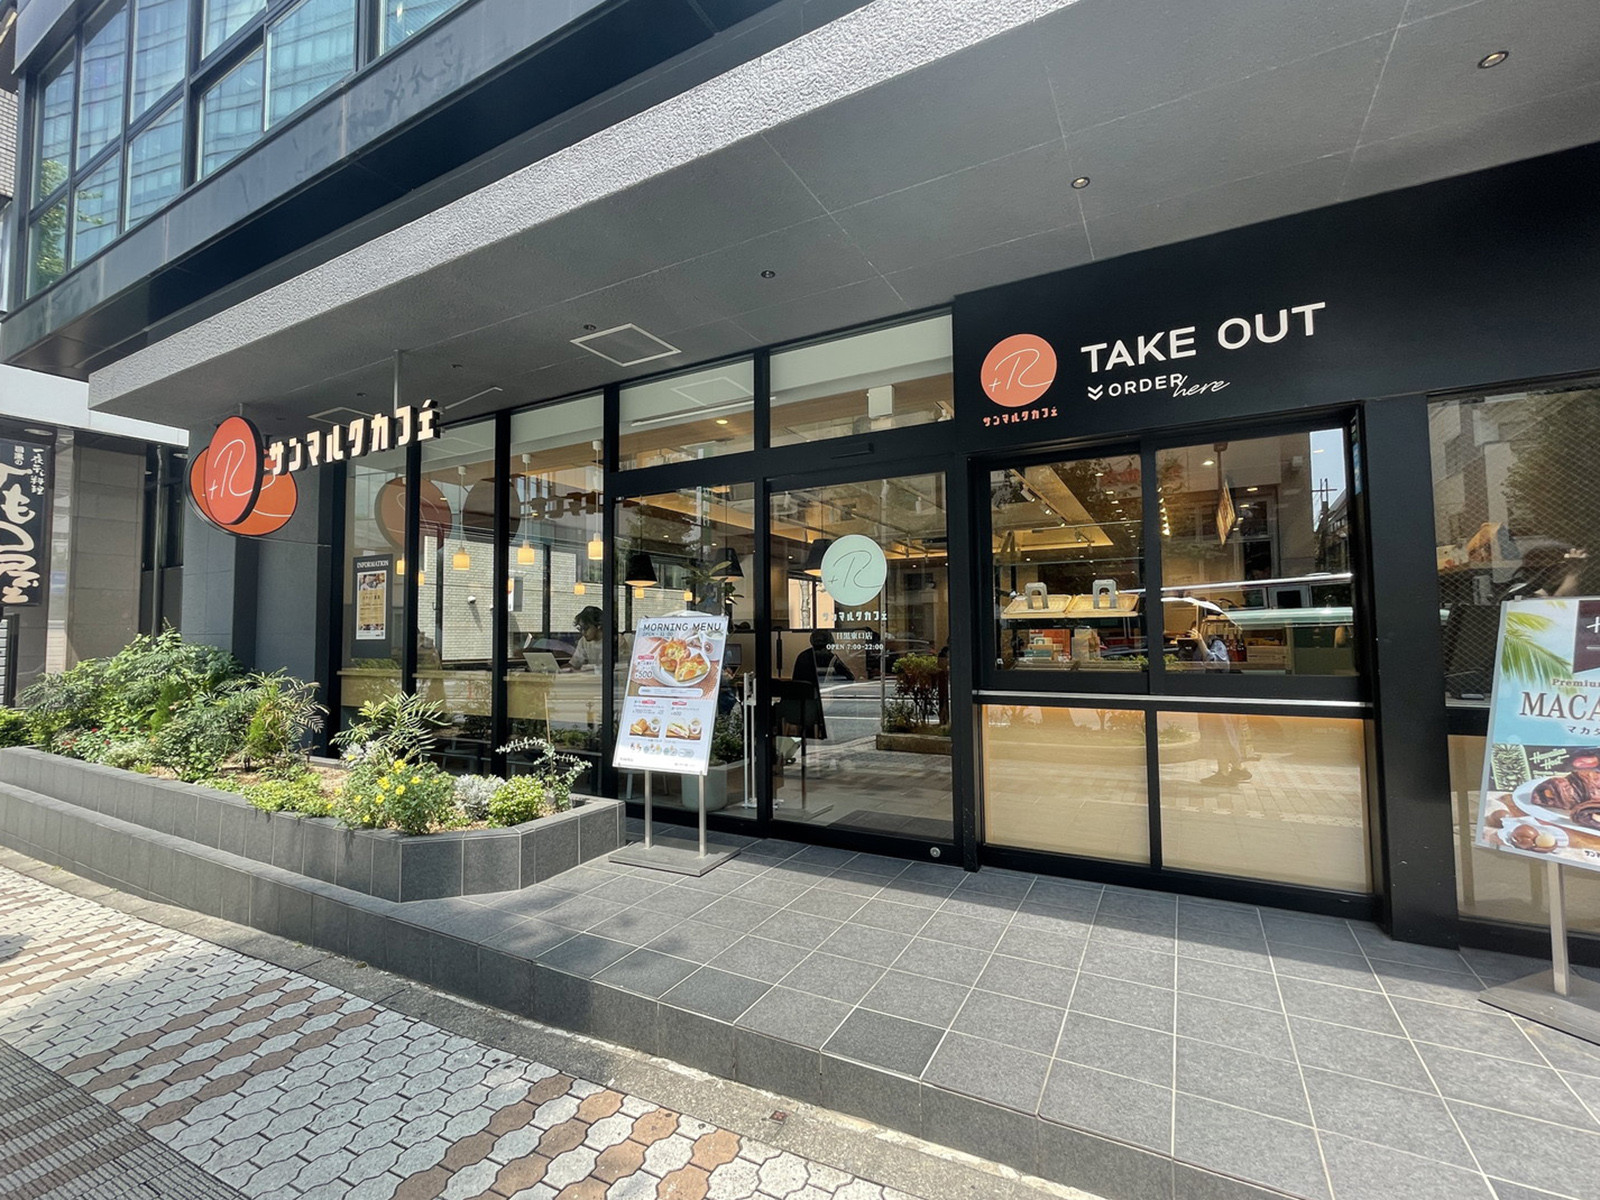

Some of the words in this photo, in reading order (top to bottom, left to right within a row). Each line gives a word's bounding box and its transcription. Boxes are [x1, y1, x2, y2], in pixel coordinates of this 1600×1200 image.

[1080, 325, 1197, 374] TAKE
[1217, 301, 1326, 350] OUT
[1107, 372, 1184, 398] ORDER
[1172, 374, 1231, 399] here
[982, 405, 1059, 428] サンマルクカフェ
[269, 399, 439, 476] サンマルクカフェ
[357, 560, 389, 569] INFORMATION
[643, 622, 689, 631] MORNING
[693, 622, 722, 631] MENU
